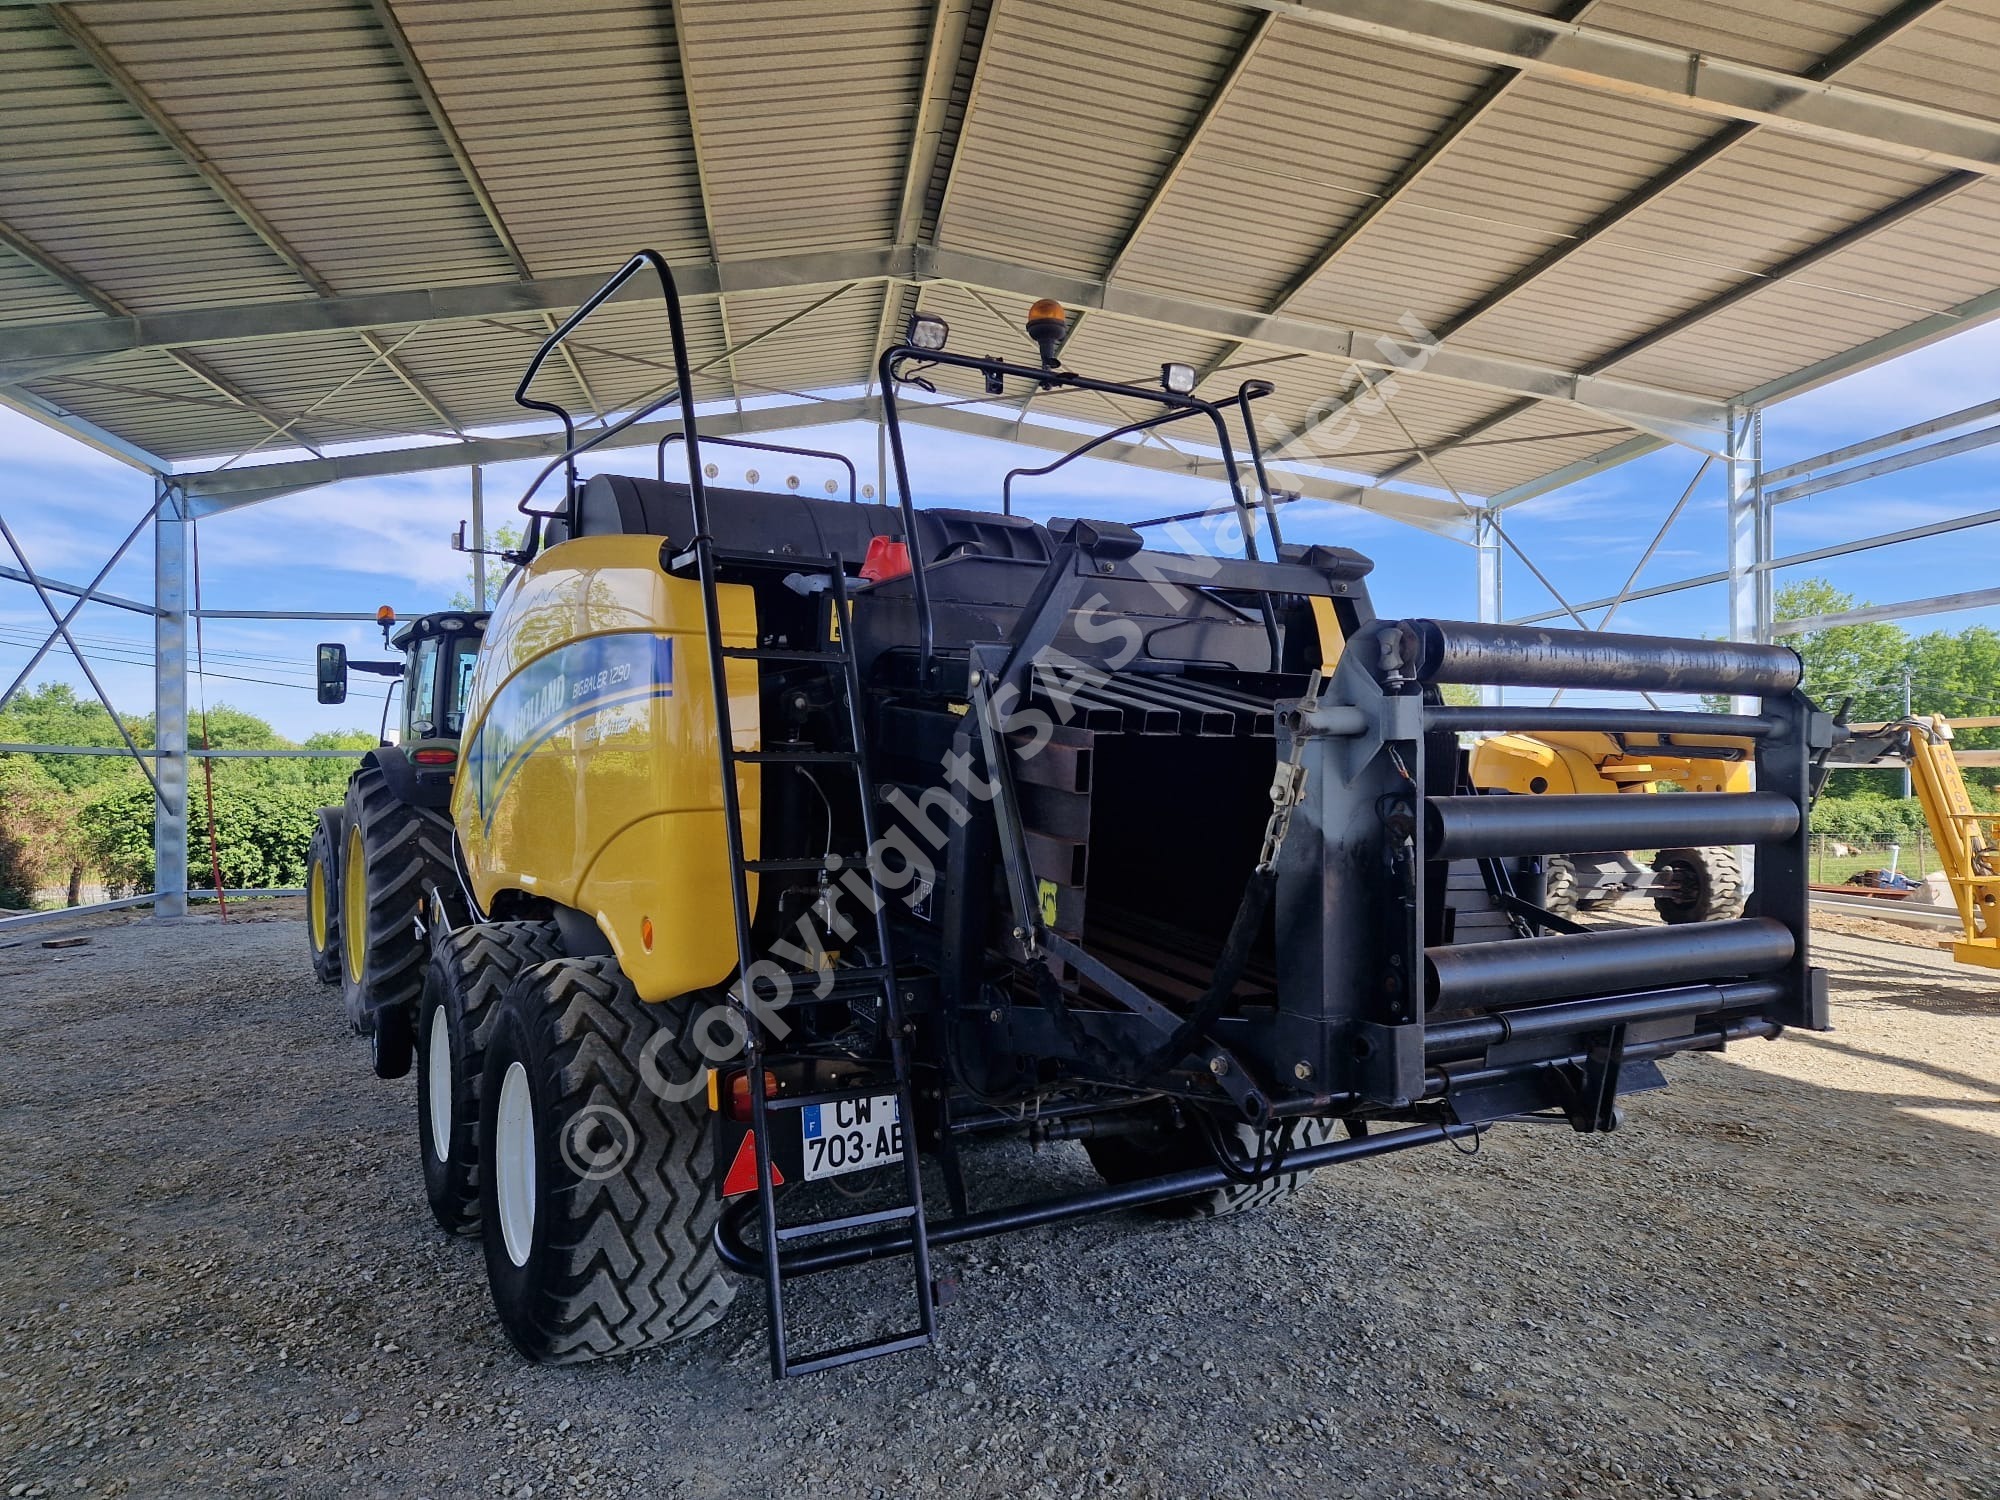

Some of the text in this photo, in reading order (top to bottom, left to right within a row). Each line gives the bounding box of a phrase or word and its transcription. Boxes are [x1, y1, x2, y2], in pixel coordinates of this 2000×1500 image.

[609, 663, 631, 686] 1290
[513, 673, 566, 745] HOLLAND
[809, 1121, 816, 1132] F
